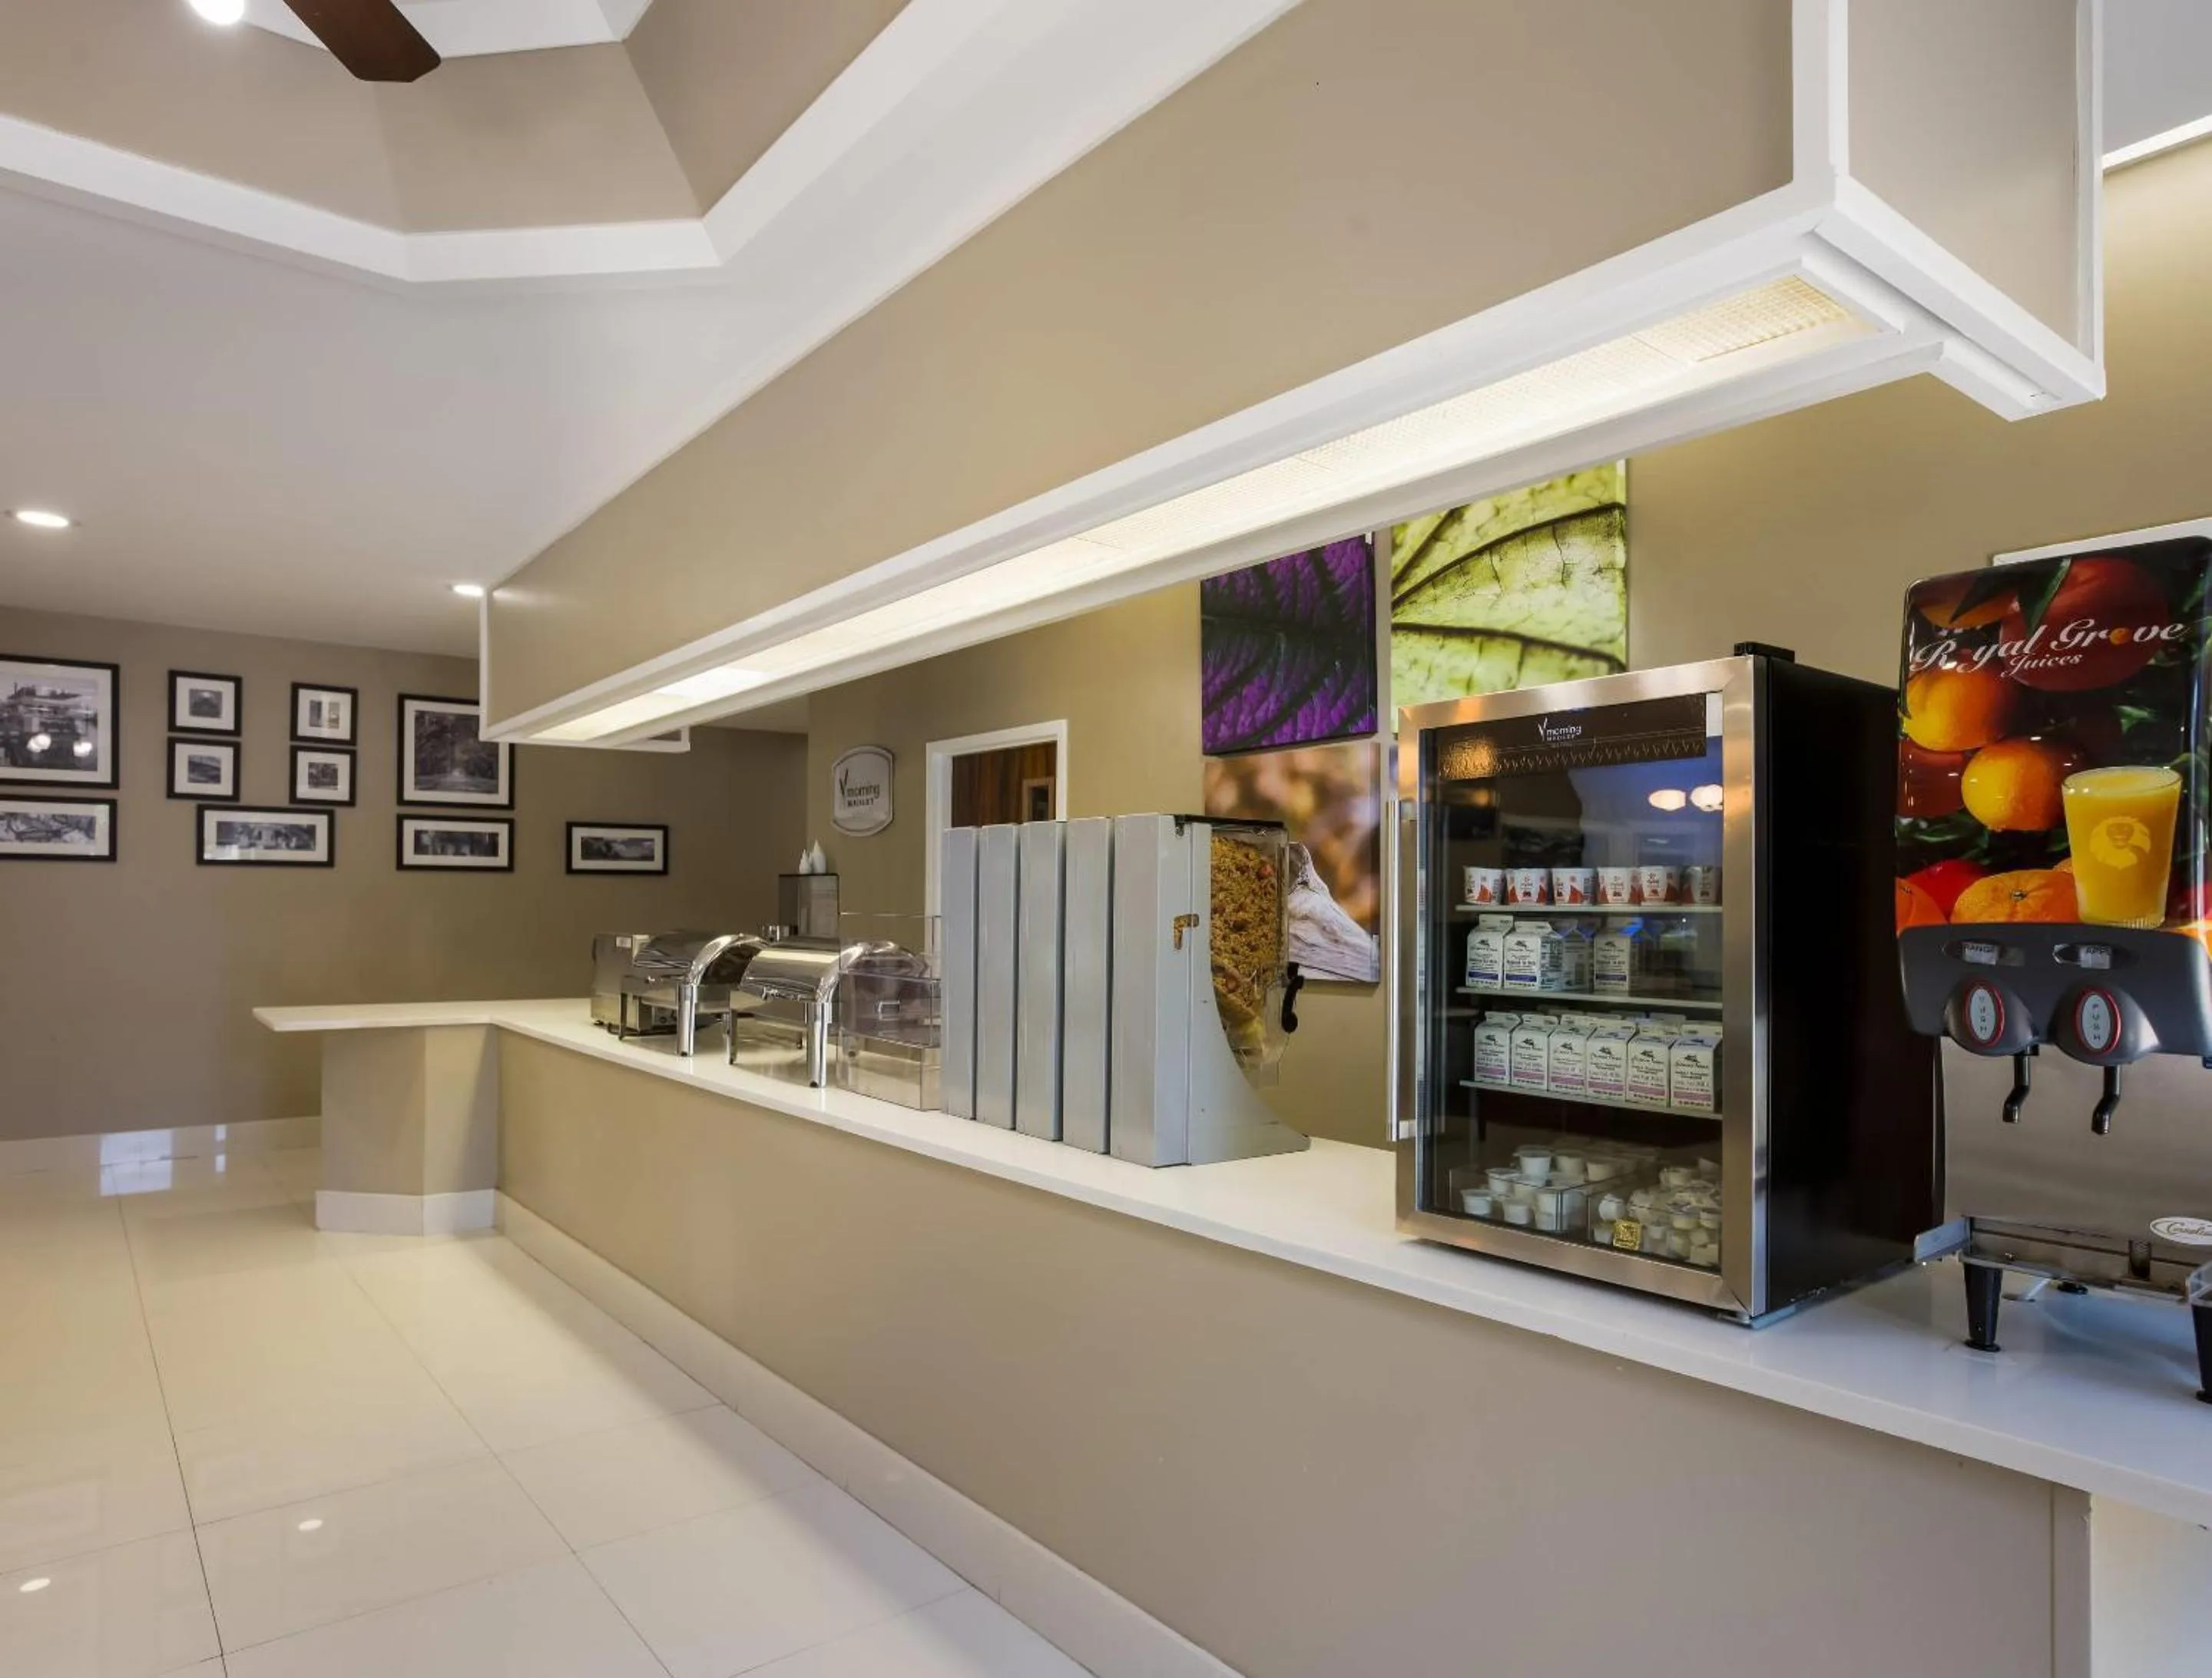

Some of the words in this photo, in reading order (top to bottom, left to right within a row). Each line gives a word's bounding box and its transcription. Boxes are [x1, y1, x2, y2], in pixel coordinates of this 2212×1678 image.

[2050, 618, 2190, 651] Grove
[2000, 653, 2084, 678] Juices
[1546, 726, 1582, 735] morning
